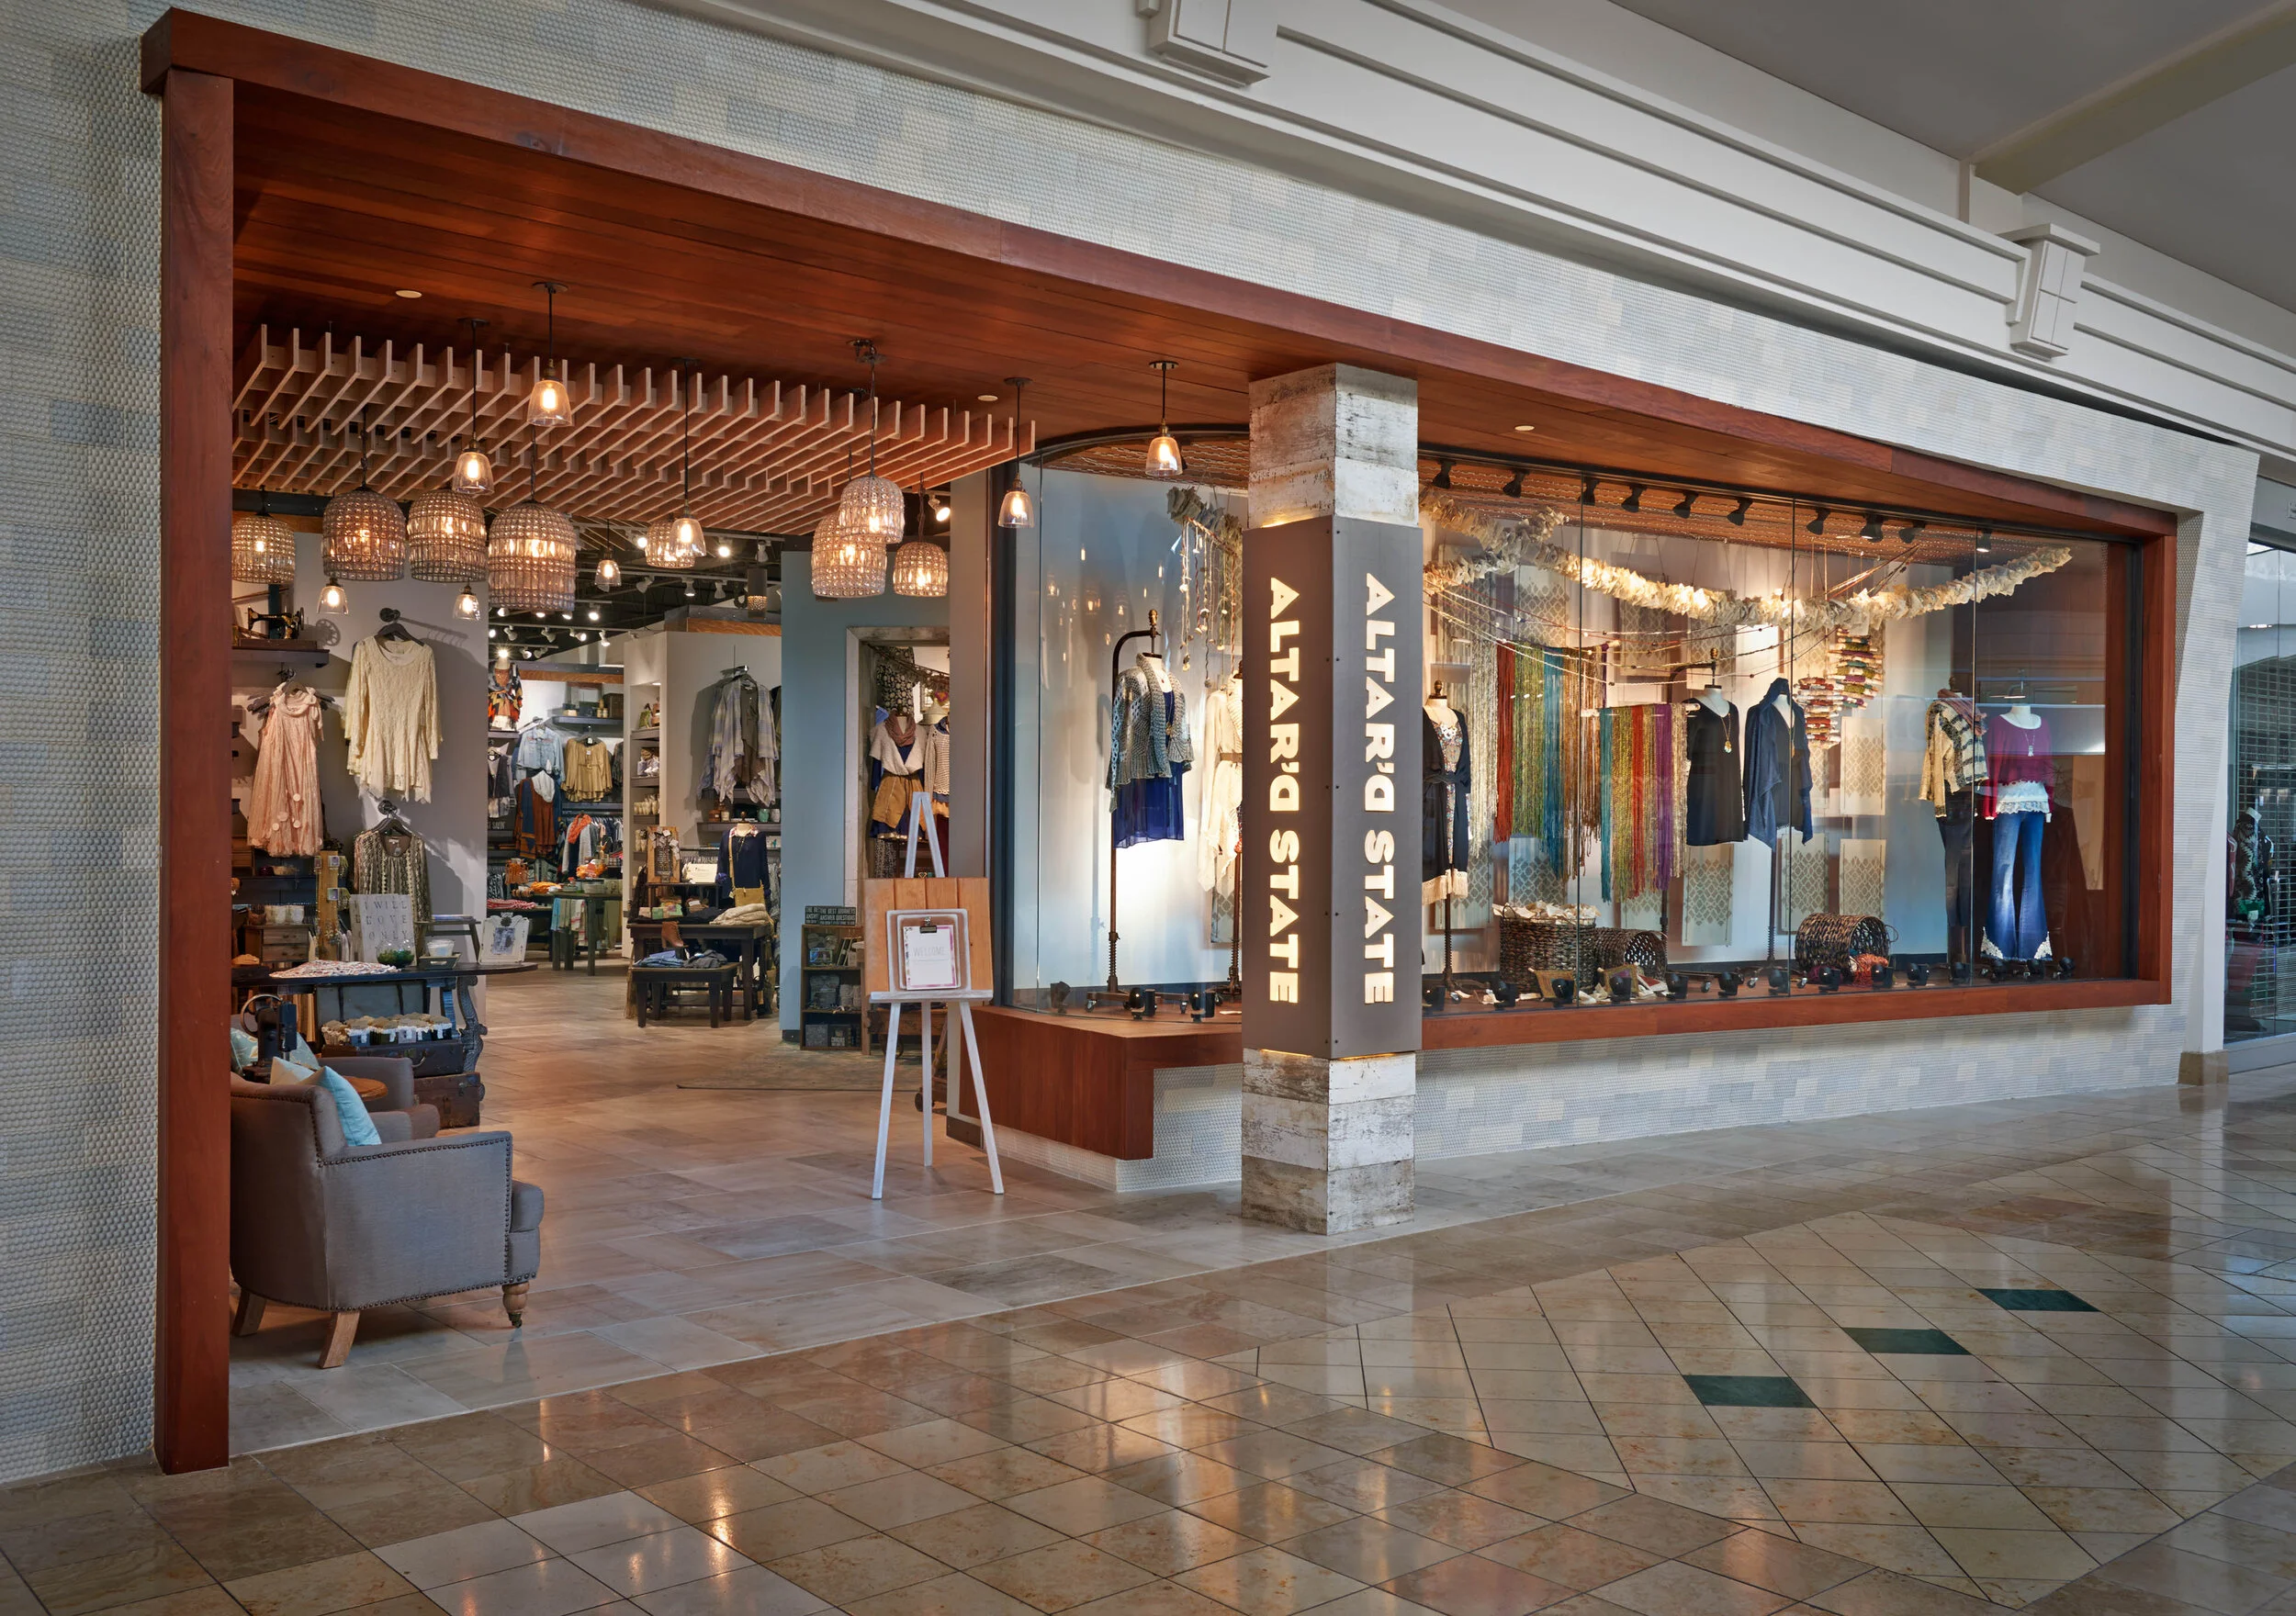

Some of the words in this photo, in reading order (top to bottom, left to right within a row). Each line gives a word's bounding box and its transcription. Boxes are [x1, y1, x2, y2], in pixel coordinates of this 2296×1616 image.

[1269, 577, 1300, 812] ALTAR'D
[1365, 572, 1395, 812] ALTAR'D
[374, 901, 407, 910] WILL
[913, 946, 947, 957] WELCOME
[1269, 828, 1300, 1004] STATE
[1364, 829, 1395, 1004] STATE
